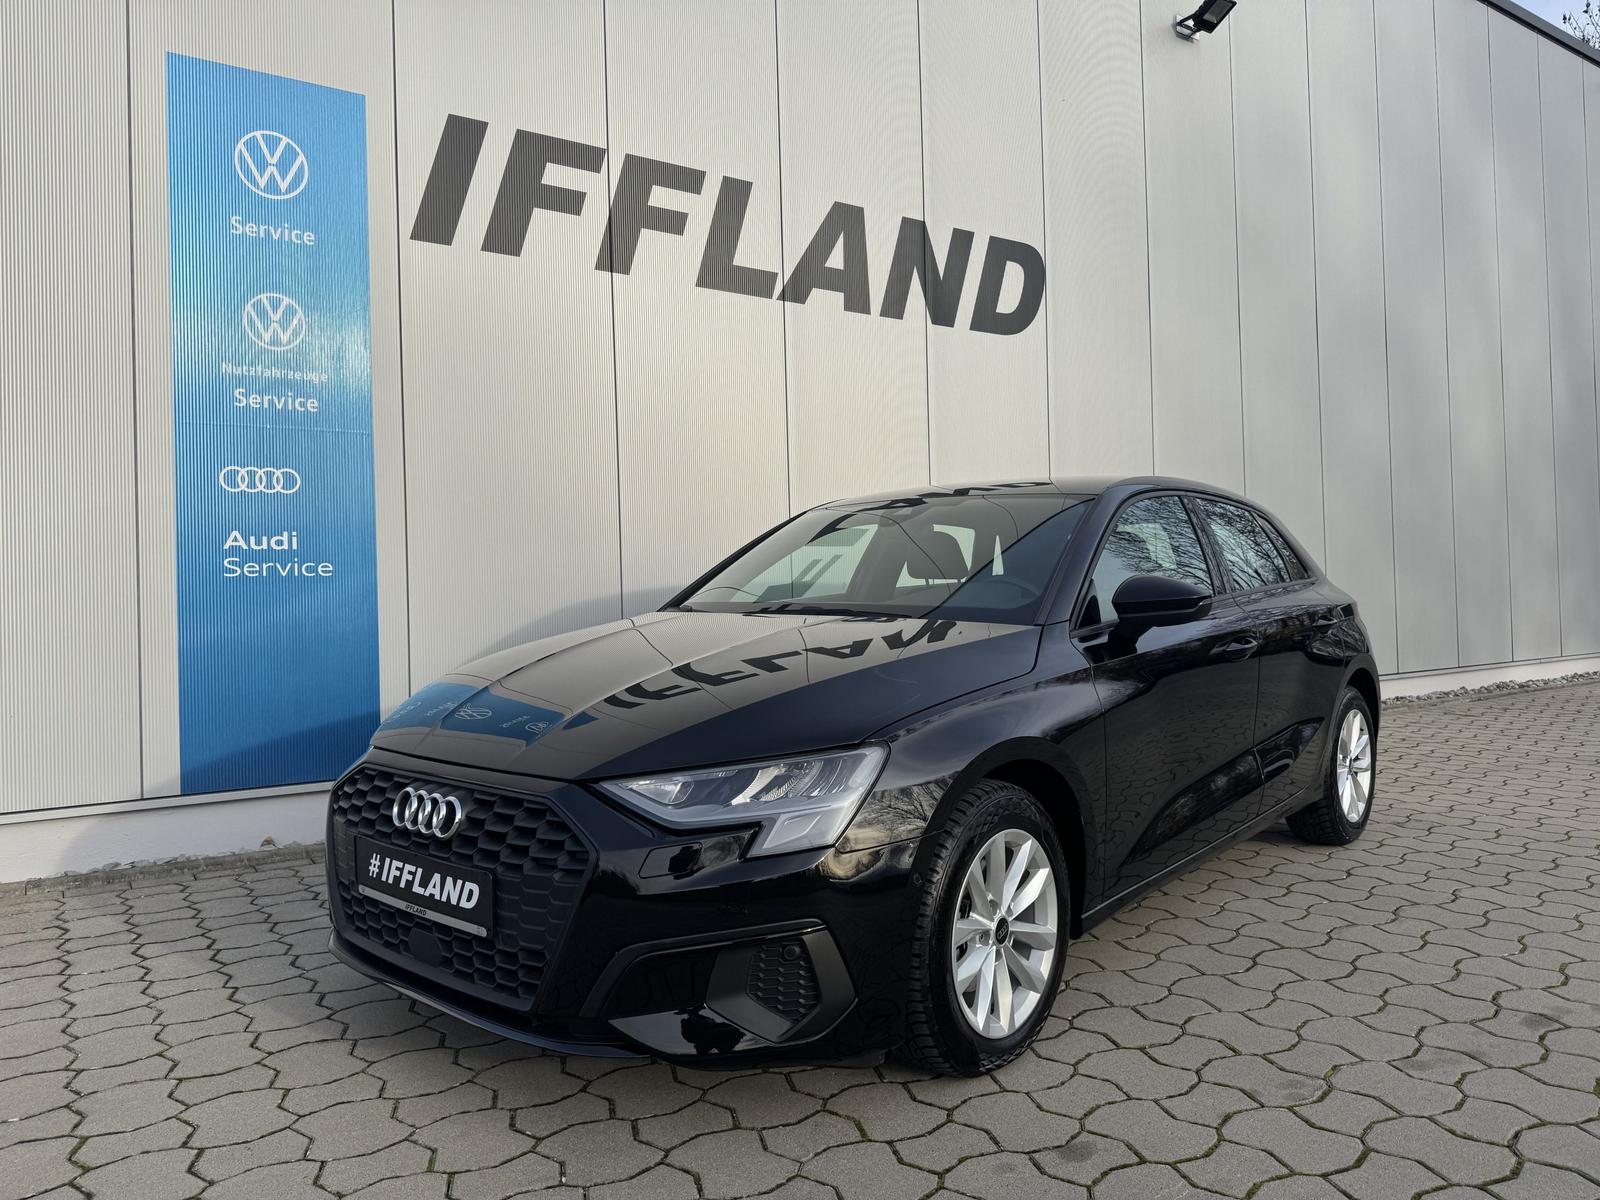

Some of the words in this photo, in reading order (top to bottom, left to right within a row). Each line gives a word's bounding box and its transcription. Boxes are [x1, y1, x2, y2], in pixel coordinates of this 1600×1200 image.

[230, 216, 315, 245] Service
[410, 113, 1046, 336] IFFLAND
[222, 362, 329, 383] Nutzfahrzeuge
[234, 388, 319, 412] Service
[223, 530, 299, 550] Audi
[223, 557, 334, 577] Service
[368, 853, 480, 909] #IFFLAND
[405, 903, 427, 916] IFFLAND
